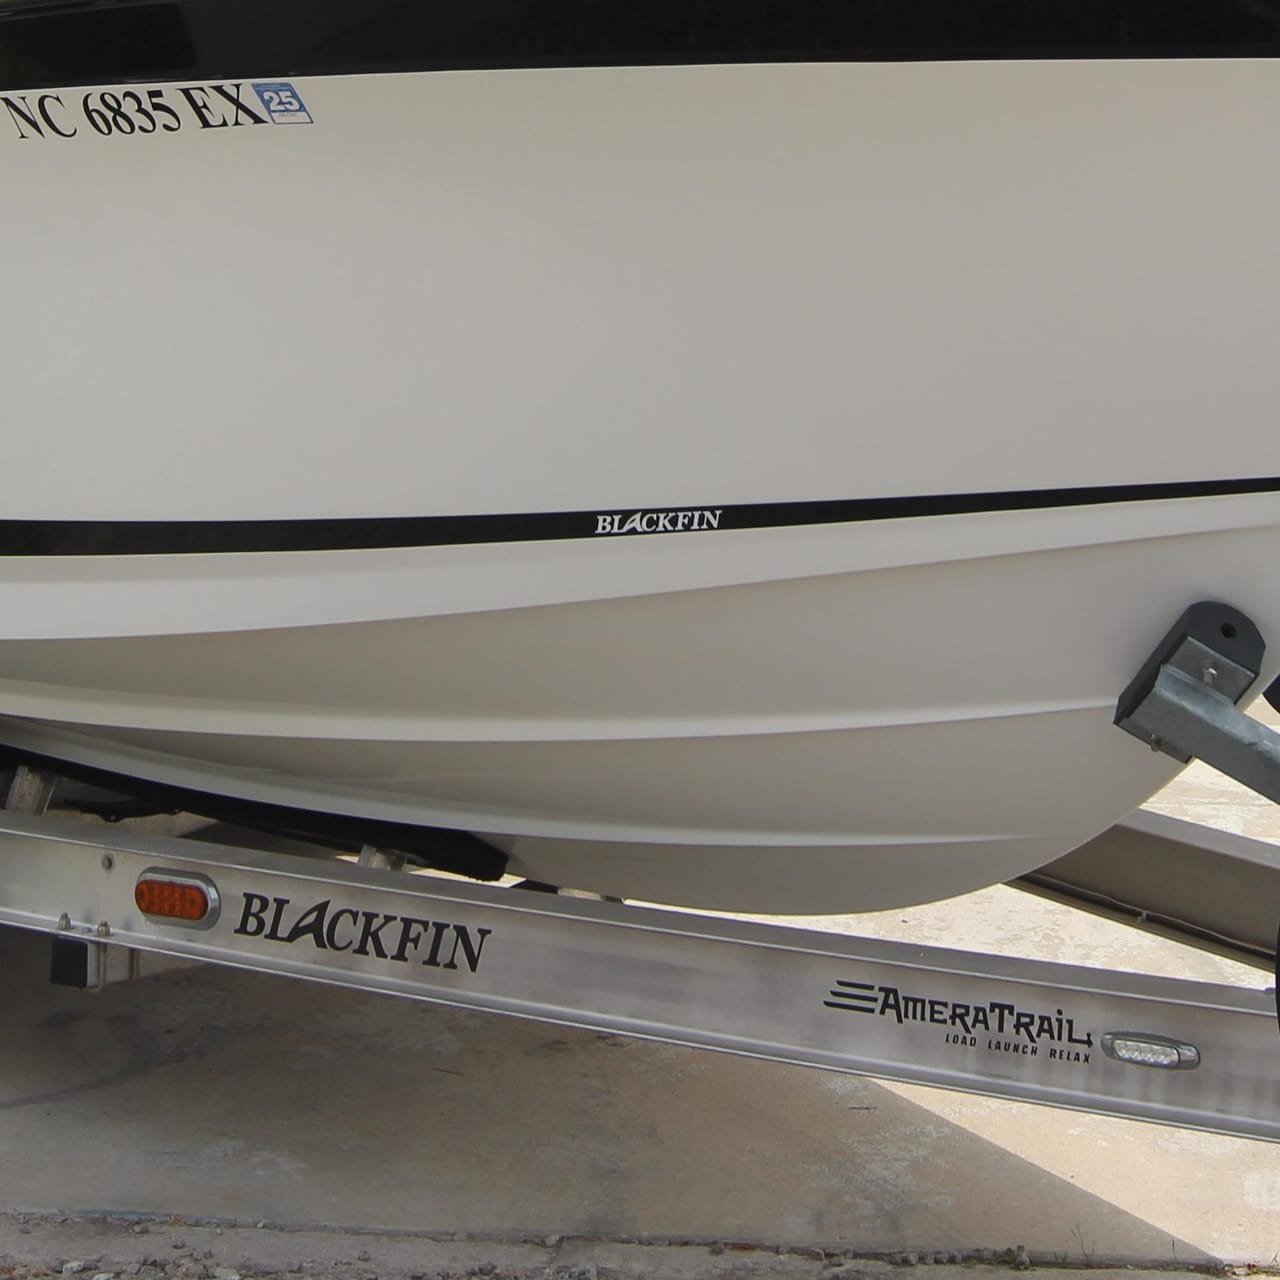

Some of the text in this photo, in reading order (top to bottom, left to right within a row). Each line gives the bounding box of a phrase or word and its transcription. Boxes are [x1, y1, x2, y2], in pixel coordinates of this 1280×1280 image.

[82, 89, 182, 137] 6835
[176, 83, 270, 130] EX
[263, 90, 300, 111] 25
[594, 509, 724, 534] BLACKFIN
[233, 891, 493, 973] BLACKFIN
[944, 1032, 1092, 1065] LOAD LAUNCH RELAX
